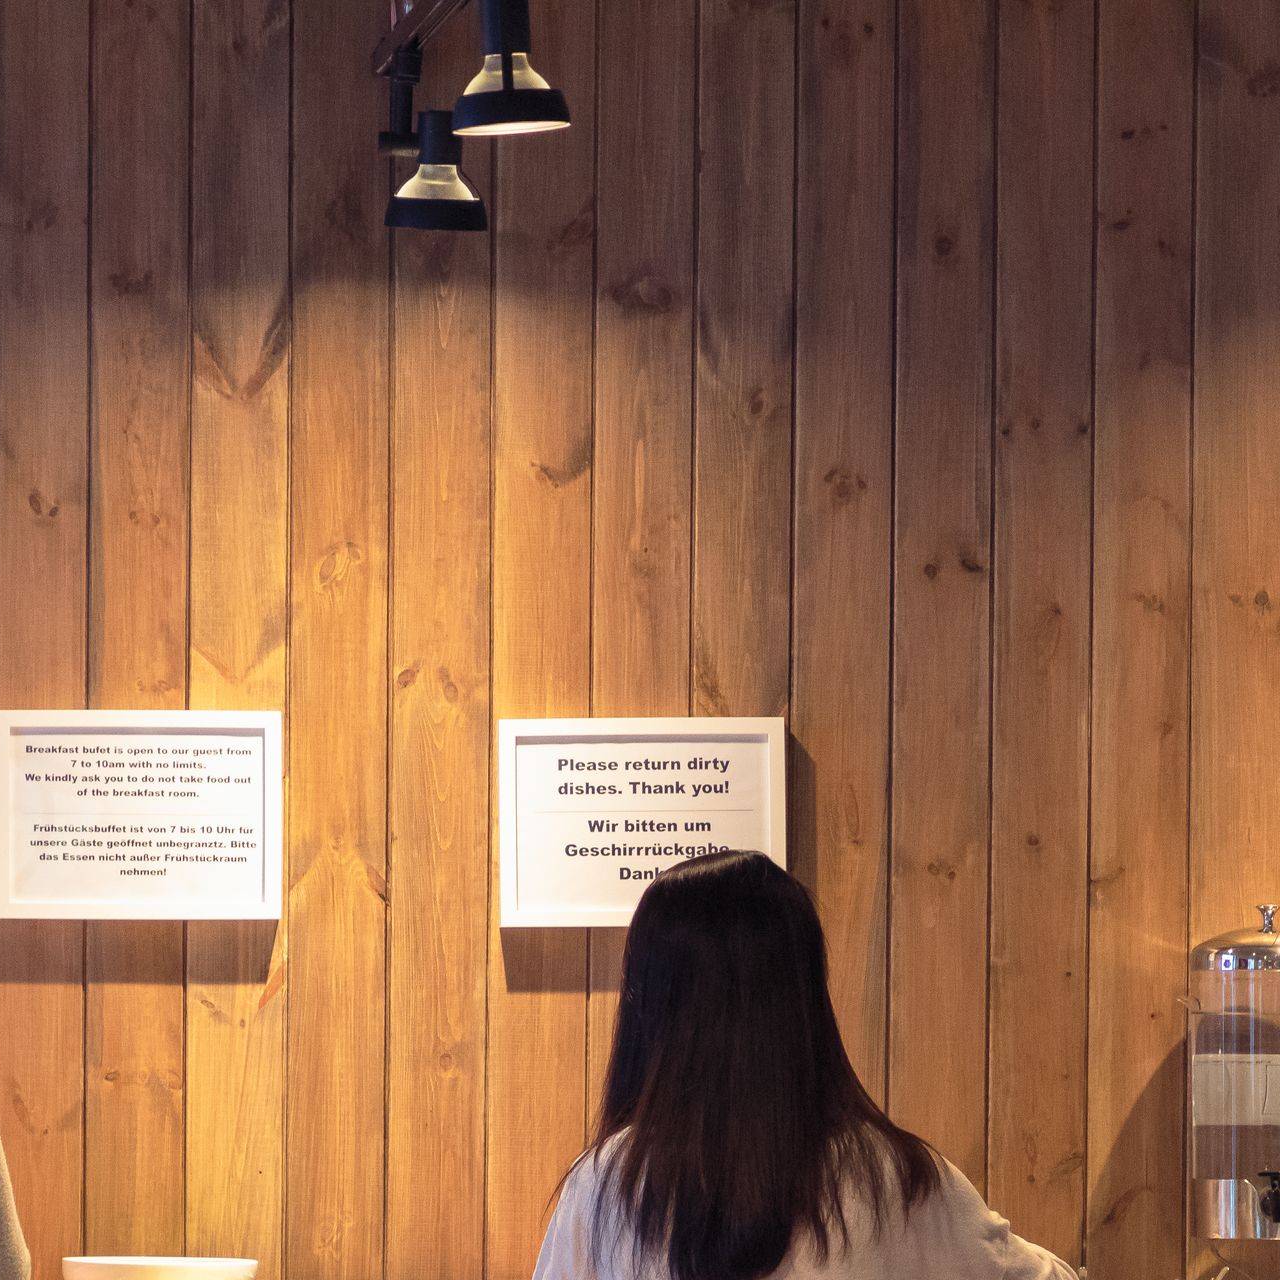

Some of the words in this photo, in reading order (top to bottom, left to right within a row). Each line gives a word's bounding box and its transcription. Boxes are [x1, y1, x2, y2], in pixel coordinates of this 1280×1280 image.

[25, 745, 79, 755] Breakfast
[82, 746, 110, 755] bufet
[114, 746, 123, 755] is
[127, 748, 153, 757] open
[157, 747, 168, 755] to
[193, 748, 223, 757] guest
[227, 747, 252, 756] from
[71, 759, 77, 768] 7
[81, 760, 91, 768] to
[95, 760, 125, 768] 10am
[129, 760, 152, 768] with
[173, 761, 206, 769] limits.
[558, 759, 618, 771] Please
[625, 758, 681, 770] return
[687, 757, 730, 773] dirty
[25, 773, 41, 782] We
[45, 773, 78, 784] kindly
[81, 774, 100, 783] ask
[104, 776, 123, 785] you
[127, 775, 138, 783] to
[141, 775, 154, 783] do
[158, 775, 176, 783] not
[207, 776, 230, 784] food
[77, 788, 88, 797] of
[92, 788, 109, 797] the
[113, 788, 164, 797] breakfast
[169, 790, 199, 798] room.
[558, 782, 622, 795] dishes.
[629, 781, 686, 794] Thank
[692, 781, 729, 797] you!
[34, 824, 127, 833] Frühstücksbuffet
[130, 825, 143, 833] ist
[170, 826, 177, 834] 7
[180, 826, 195, 834] bis
[200, 826, 212, 834] 10
[217, 826, 235, 834] Uhr
[588, 820, 619, 832] Wir
[625, 820, 678, 832] bitten
[684, 822, 711, 832] um
[71, 839, 103, 848] Gäste
[107, 839, 152, 850] geöffnet
[231, 841, 257, 849] Bitte
[39, 853, 58, 862] das
[62, 853, 95, 862] Essen
[98, 853, 126, 862] nicht
[129, 854, 161, 862] außer
[165, 853, 248, 863] Frühstückraum
[120, 867, 167, 876] nehmen!
